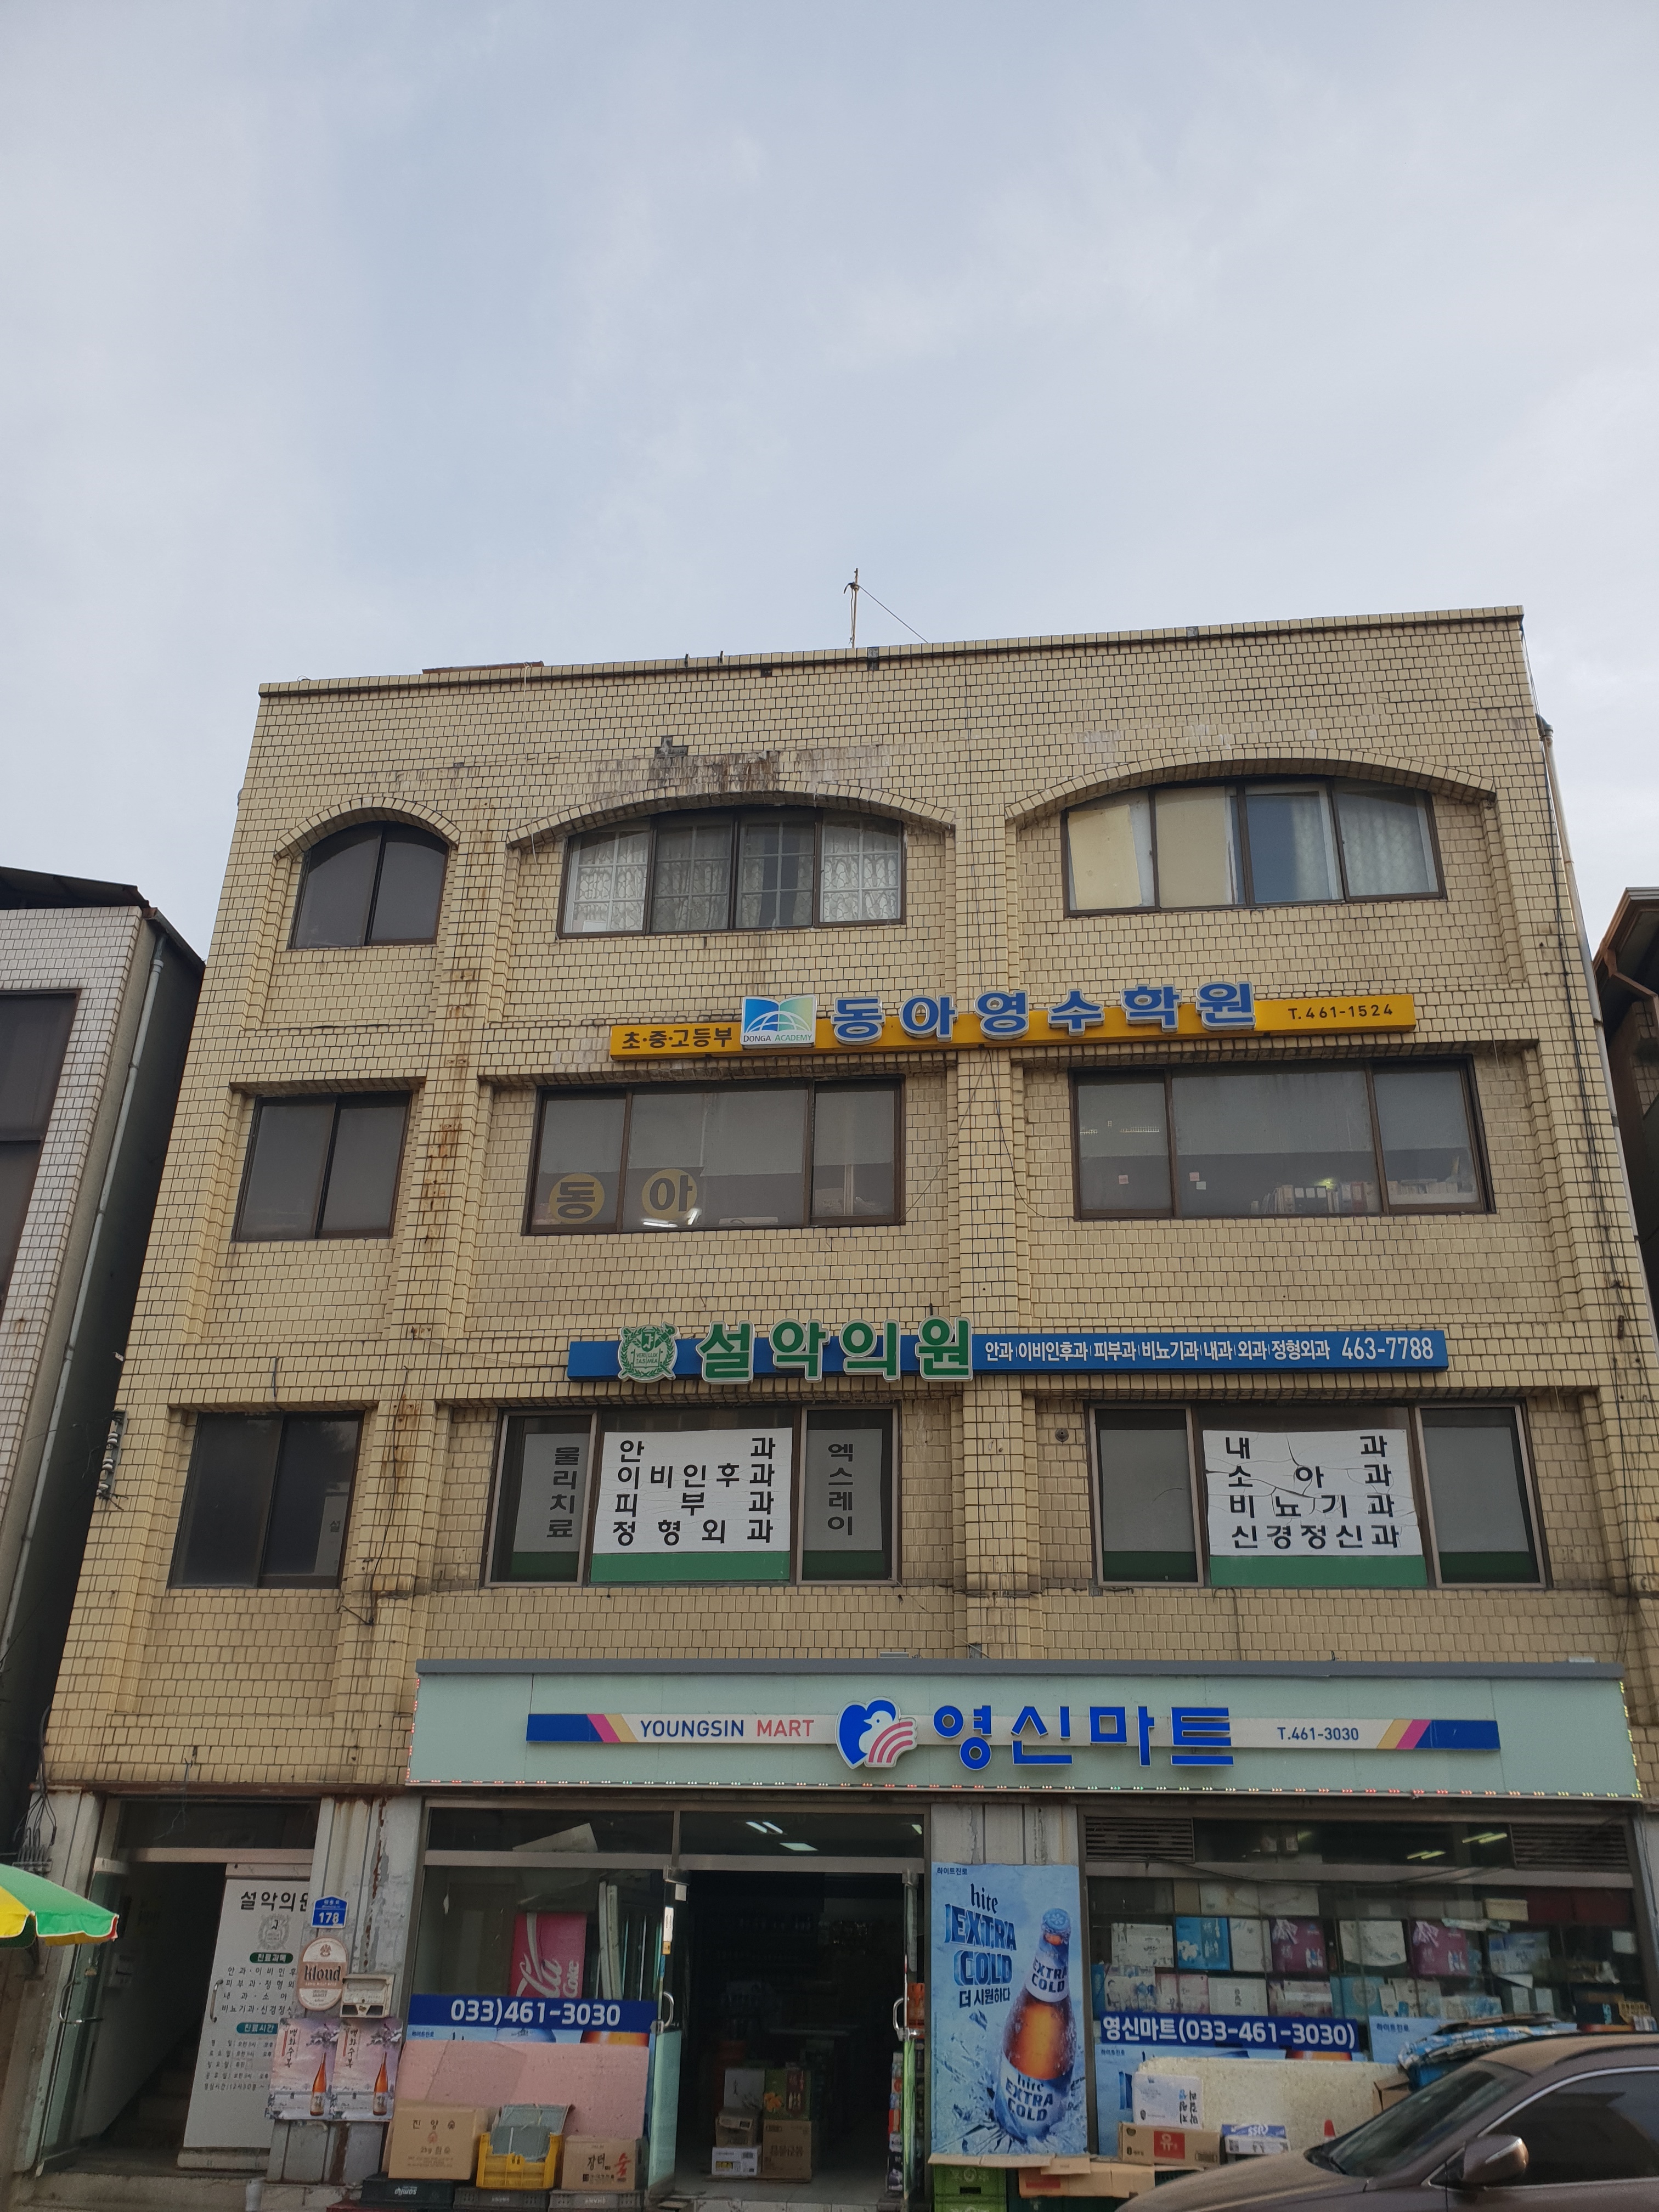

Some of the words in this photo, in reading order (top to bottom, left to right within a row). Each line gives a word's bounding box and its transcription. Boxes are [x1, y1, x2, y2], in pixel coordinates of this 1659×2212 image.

[831, 981, 1256, 1045] 동아영수학원
[1288, 1003, 1393, 1020] T.461-1524
[742, 1034, 771, 1043] DONGA
[774, 1033, 812, 1042] ACADEMY
[556, 1181, 596, 1220] 동
[648, 1175, 693, 1213] 아
[698, 1317, 972, 1381] 설악의원
[985, 1341, 1013, 1361] 안과
[1018, 1340, 1088, 1361] 이비인후과
[1093, 1340, 1136, 1360] 피부과
[1142, 1340, 1198, 1360] 비뇨기과
[1204, 1340, 1233, 1360] 내과
[1238, 1340, 1267, 1360] 외과
[1271, 1339, 1330, 1361] 정형외과
[1341, 1336, 1434, 1361] 463-7788
[617, 1462, 775, 1490] 이비인후과
[826, 1442, 854, 1537] 엑스레이
[546, 1446, 581, 1538] 물리치료
[1231, 1523, 1400, 1550] 신경정신과
[640, 1719, 744, 1738] YOUNGSIN
[757, 1719, 814, 1737] MART
[933, 1704, 1234, 1770] 영신마트
[1277, 1726, 1359, 1742] T.461-3030
[936, 1867, 968, 1875] 하이트진로
[970, 1883, 998, 1914] hite
[319, 1912, 340, 1923] 178
[944, 1903, 1017, 1951] EXTRA
[303, 1964, 341, 1982] kloud
[953, 1950, 1013, 1986] COLD
[1032, 1958, 1068, 1980] EXTRA
[1031, 1973, 1065, 1993] COLD
[959, 1989, 971, 2008] 더
[974, 1987, 1011, 2006] 시원하다
[450, 1997, 621, 2026] 033)461-3030
[1005, 2076, 1054, 2107] EXTRA
[1007, 2097, 1047, 2121] COLD
